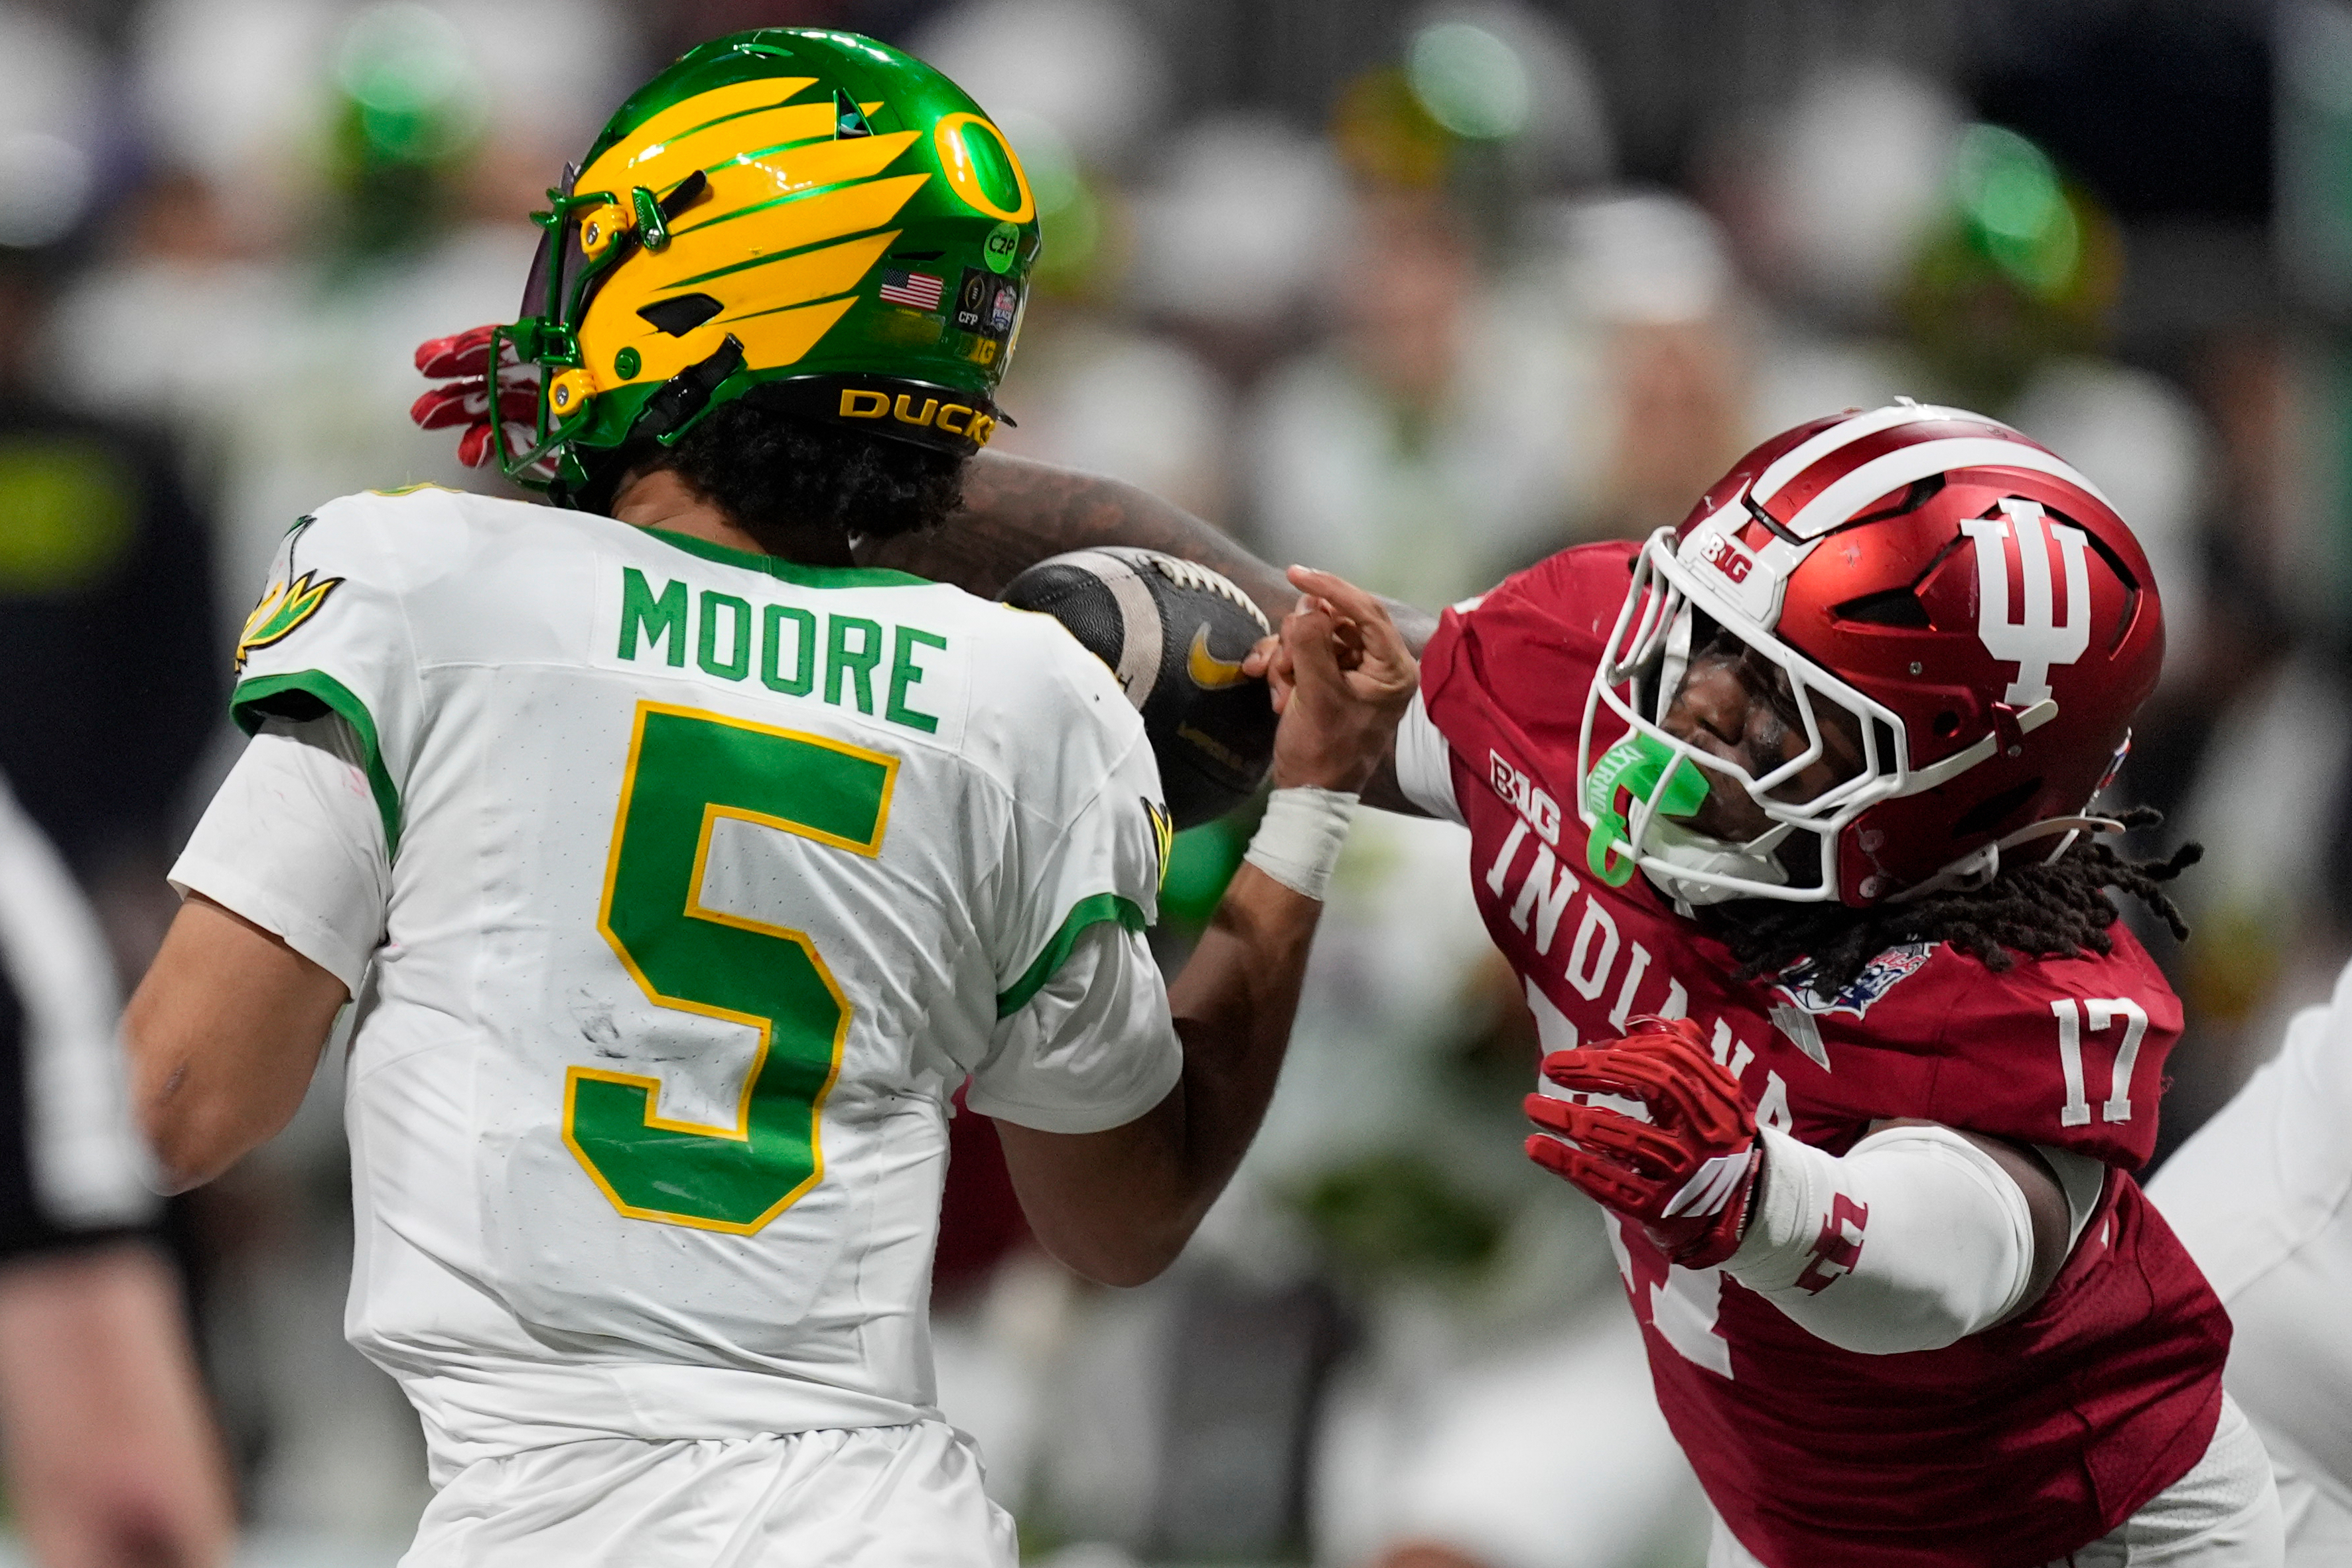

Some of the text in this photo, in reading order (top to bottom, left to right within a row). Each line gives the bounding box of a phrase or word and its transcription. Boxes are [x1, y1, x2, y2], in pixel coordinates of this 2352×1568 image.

[989, 235, 1016, 255] C2P
[959, 311, 979, 326] CFP
[618, 566, 947, 734] MOORE
[561, 699, 901, 1236] 5
[2050, 997, 2149, 1127] 17
